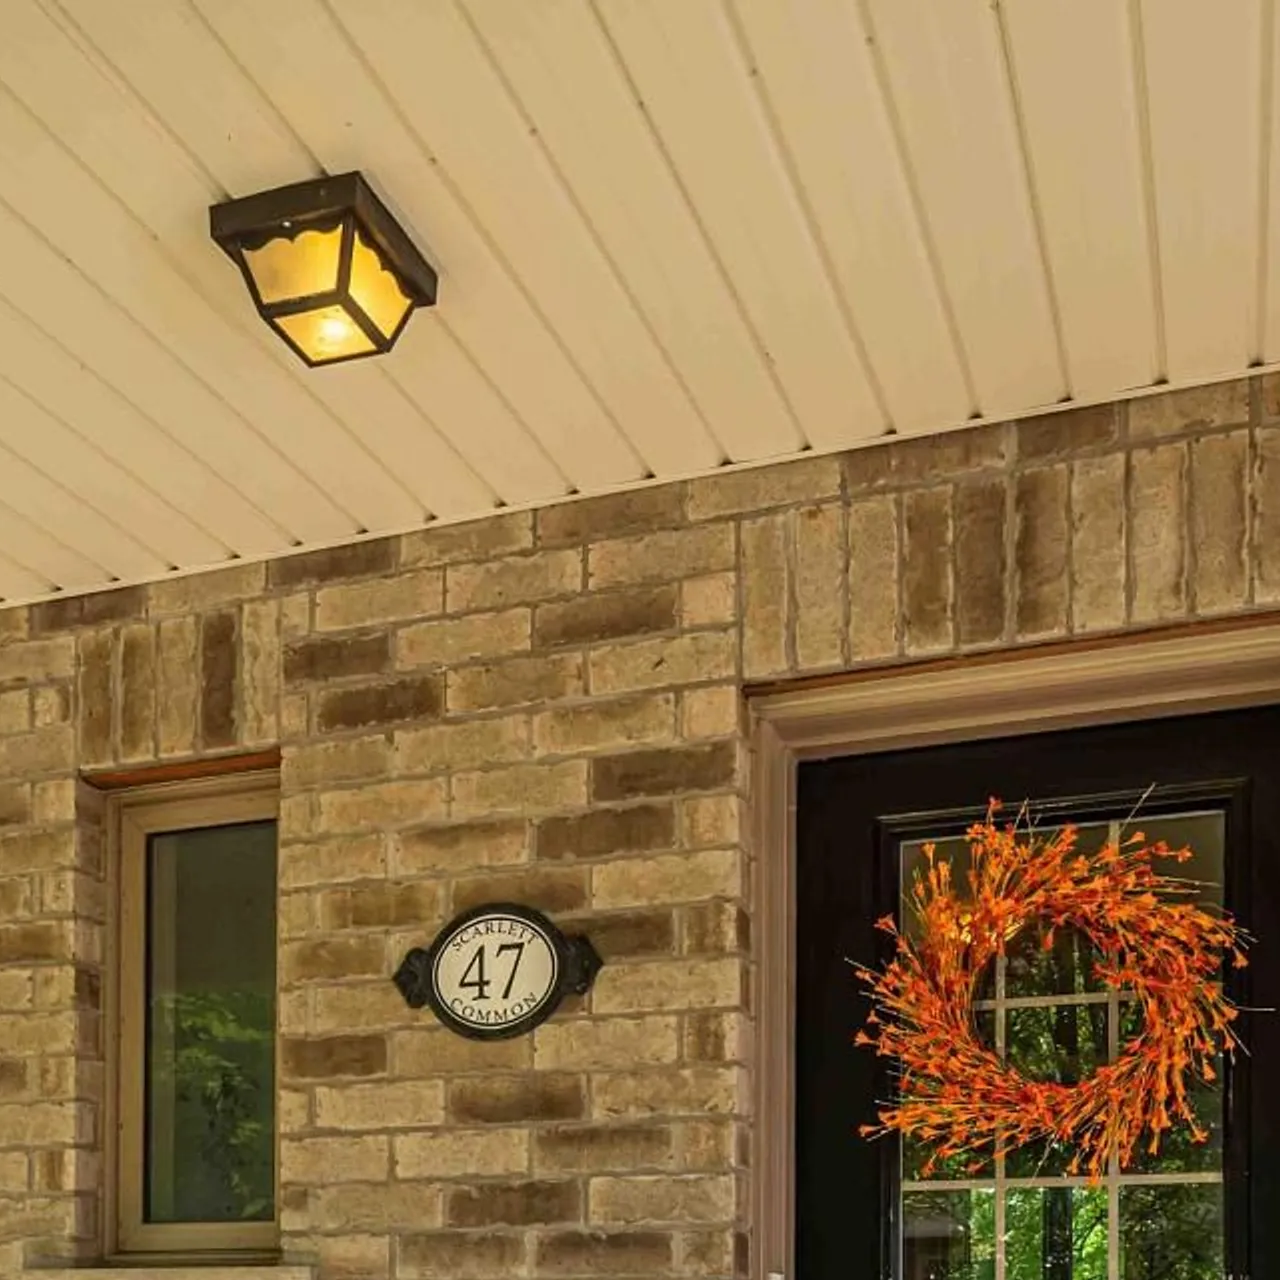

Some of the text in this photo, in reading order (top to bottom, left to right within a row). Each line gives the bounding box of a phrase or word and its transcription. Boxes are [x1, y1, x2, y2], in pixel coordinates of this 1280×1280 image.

[452, 920, 539, 950] SCARLETT
[459, 942, 525, 1001] 47
[450, 993, 539, 1023] COMMON
